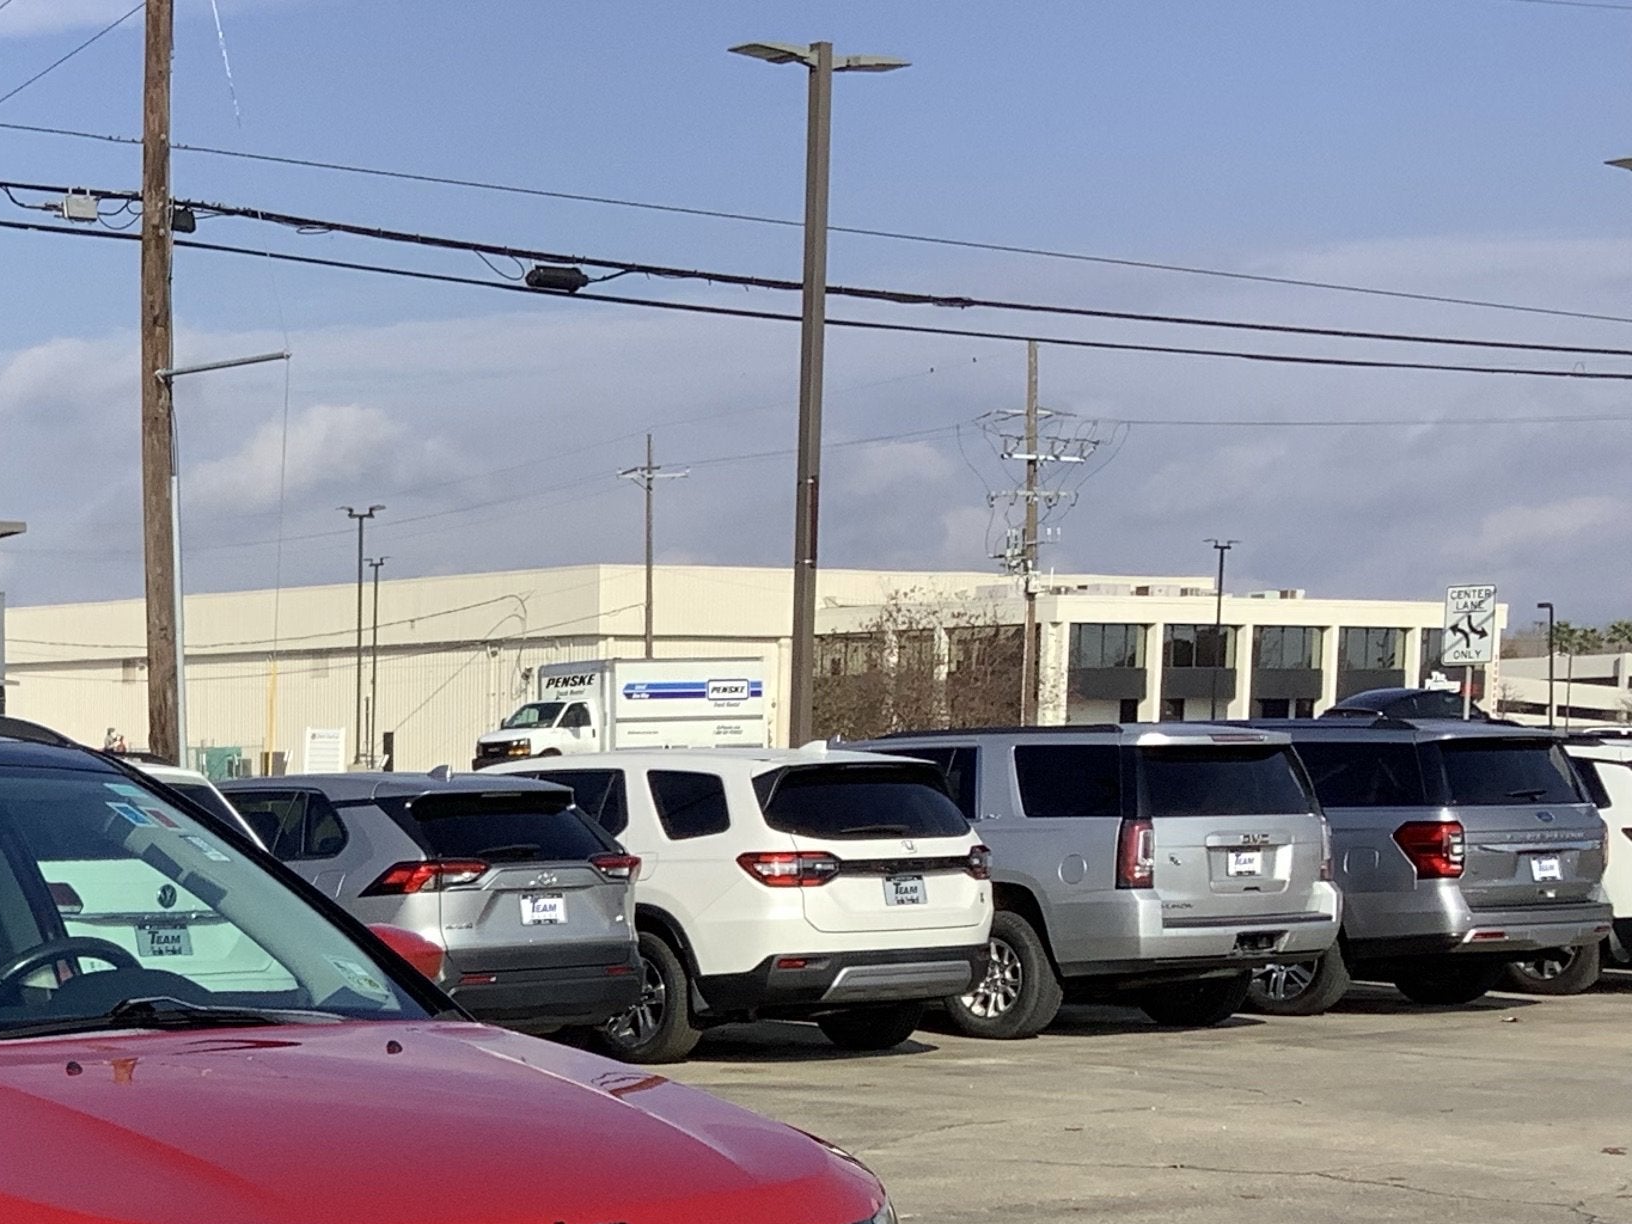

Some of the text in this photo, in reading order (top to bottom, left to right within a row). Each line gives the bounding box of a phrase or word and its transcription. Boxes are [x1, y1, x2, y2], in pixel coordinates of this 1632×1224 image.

[1450, 588, 1493, 600] CENTER
[1456, 600, 1485, 610] LANE
[1453, 649, 1482, 660] ONLY
[545, 673, 596, 689] PENSKE
[711, 685, 746, 694] PENSKE
[893, 882, 918, 895] TEAM
[530, 897, 557, 913] TEAM
[148, 930, 181, 944] TEAM
